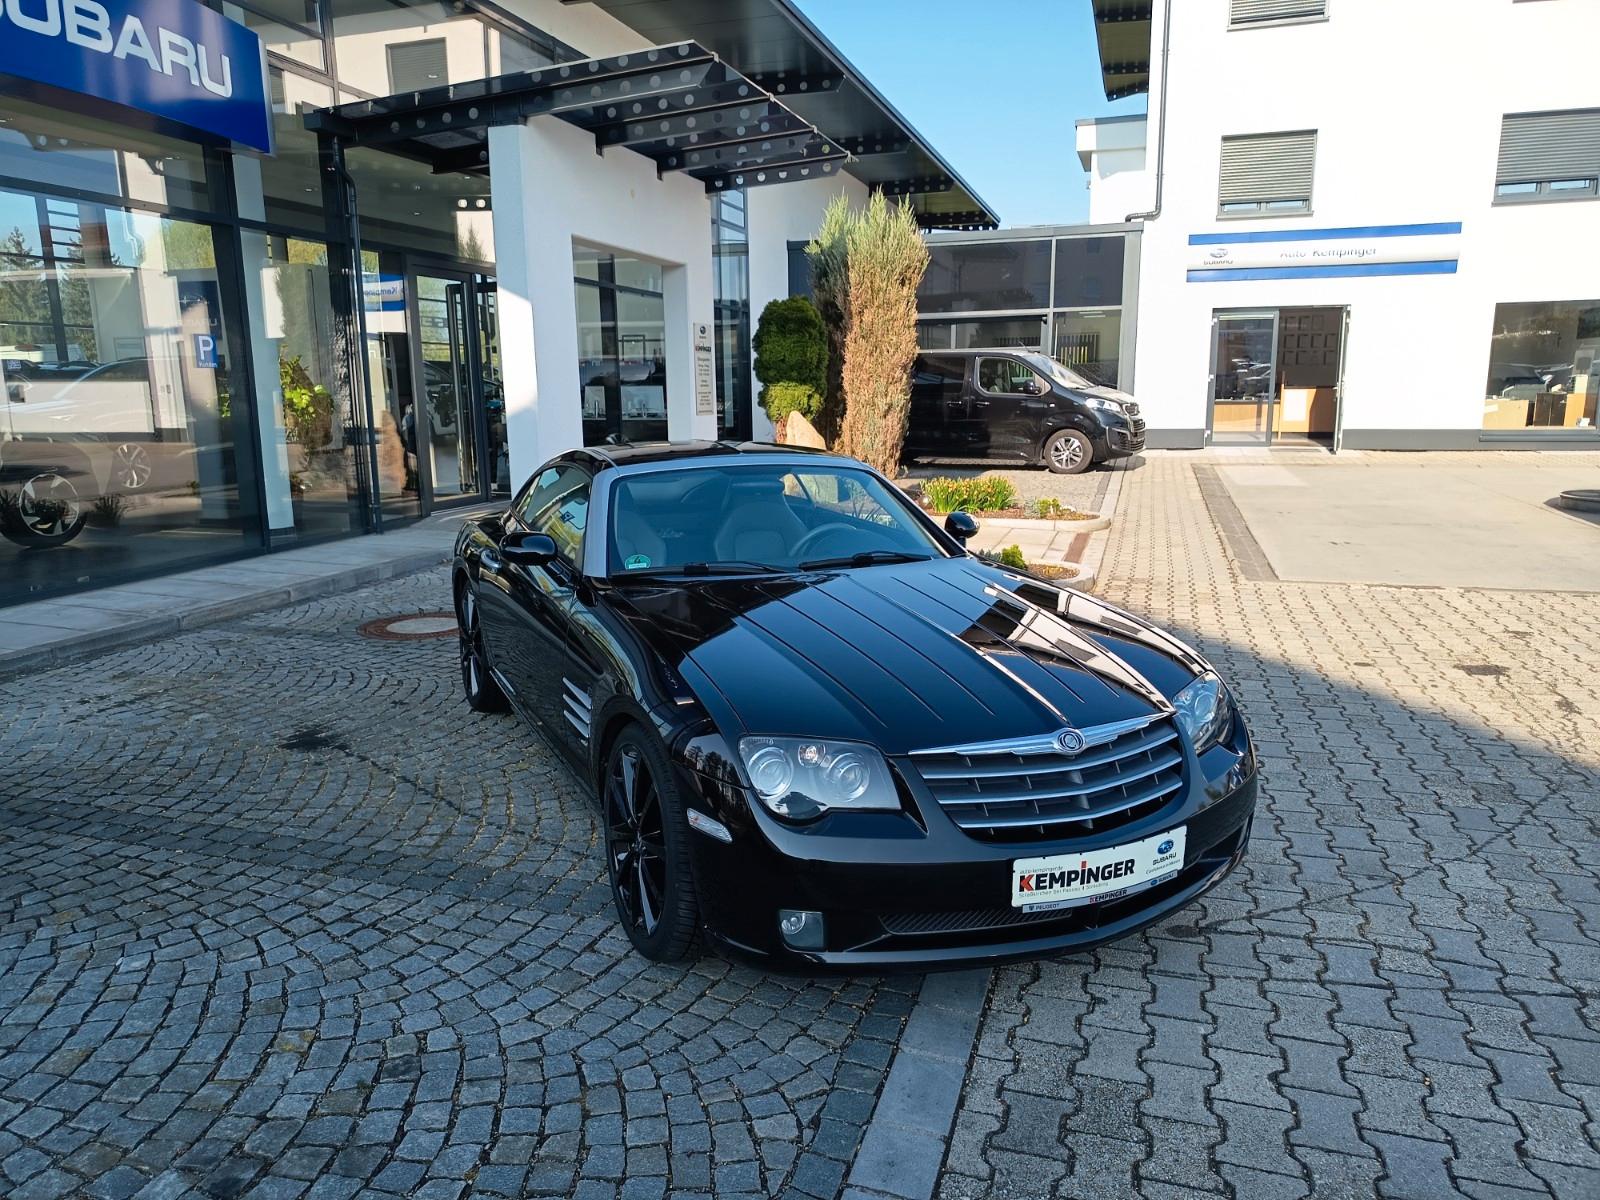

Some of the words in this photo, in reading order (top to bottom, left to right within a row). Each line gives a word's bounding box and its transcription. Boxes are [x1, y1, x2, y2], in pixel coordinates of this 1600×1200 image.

[0, 0, 233, 98] UBARU
[1312, 247, 1377, 258] Kempinger
[198, 335, 214, 361] P
[1153, 852, 1176, 865] SUBARU
[1019, 859, 1135, 892] KEMPINGER
[1090, 889, 1128, 903] KEMPINGER
